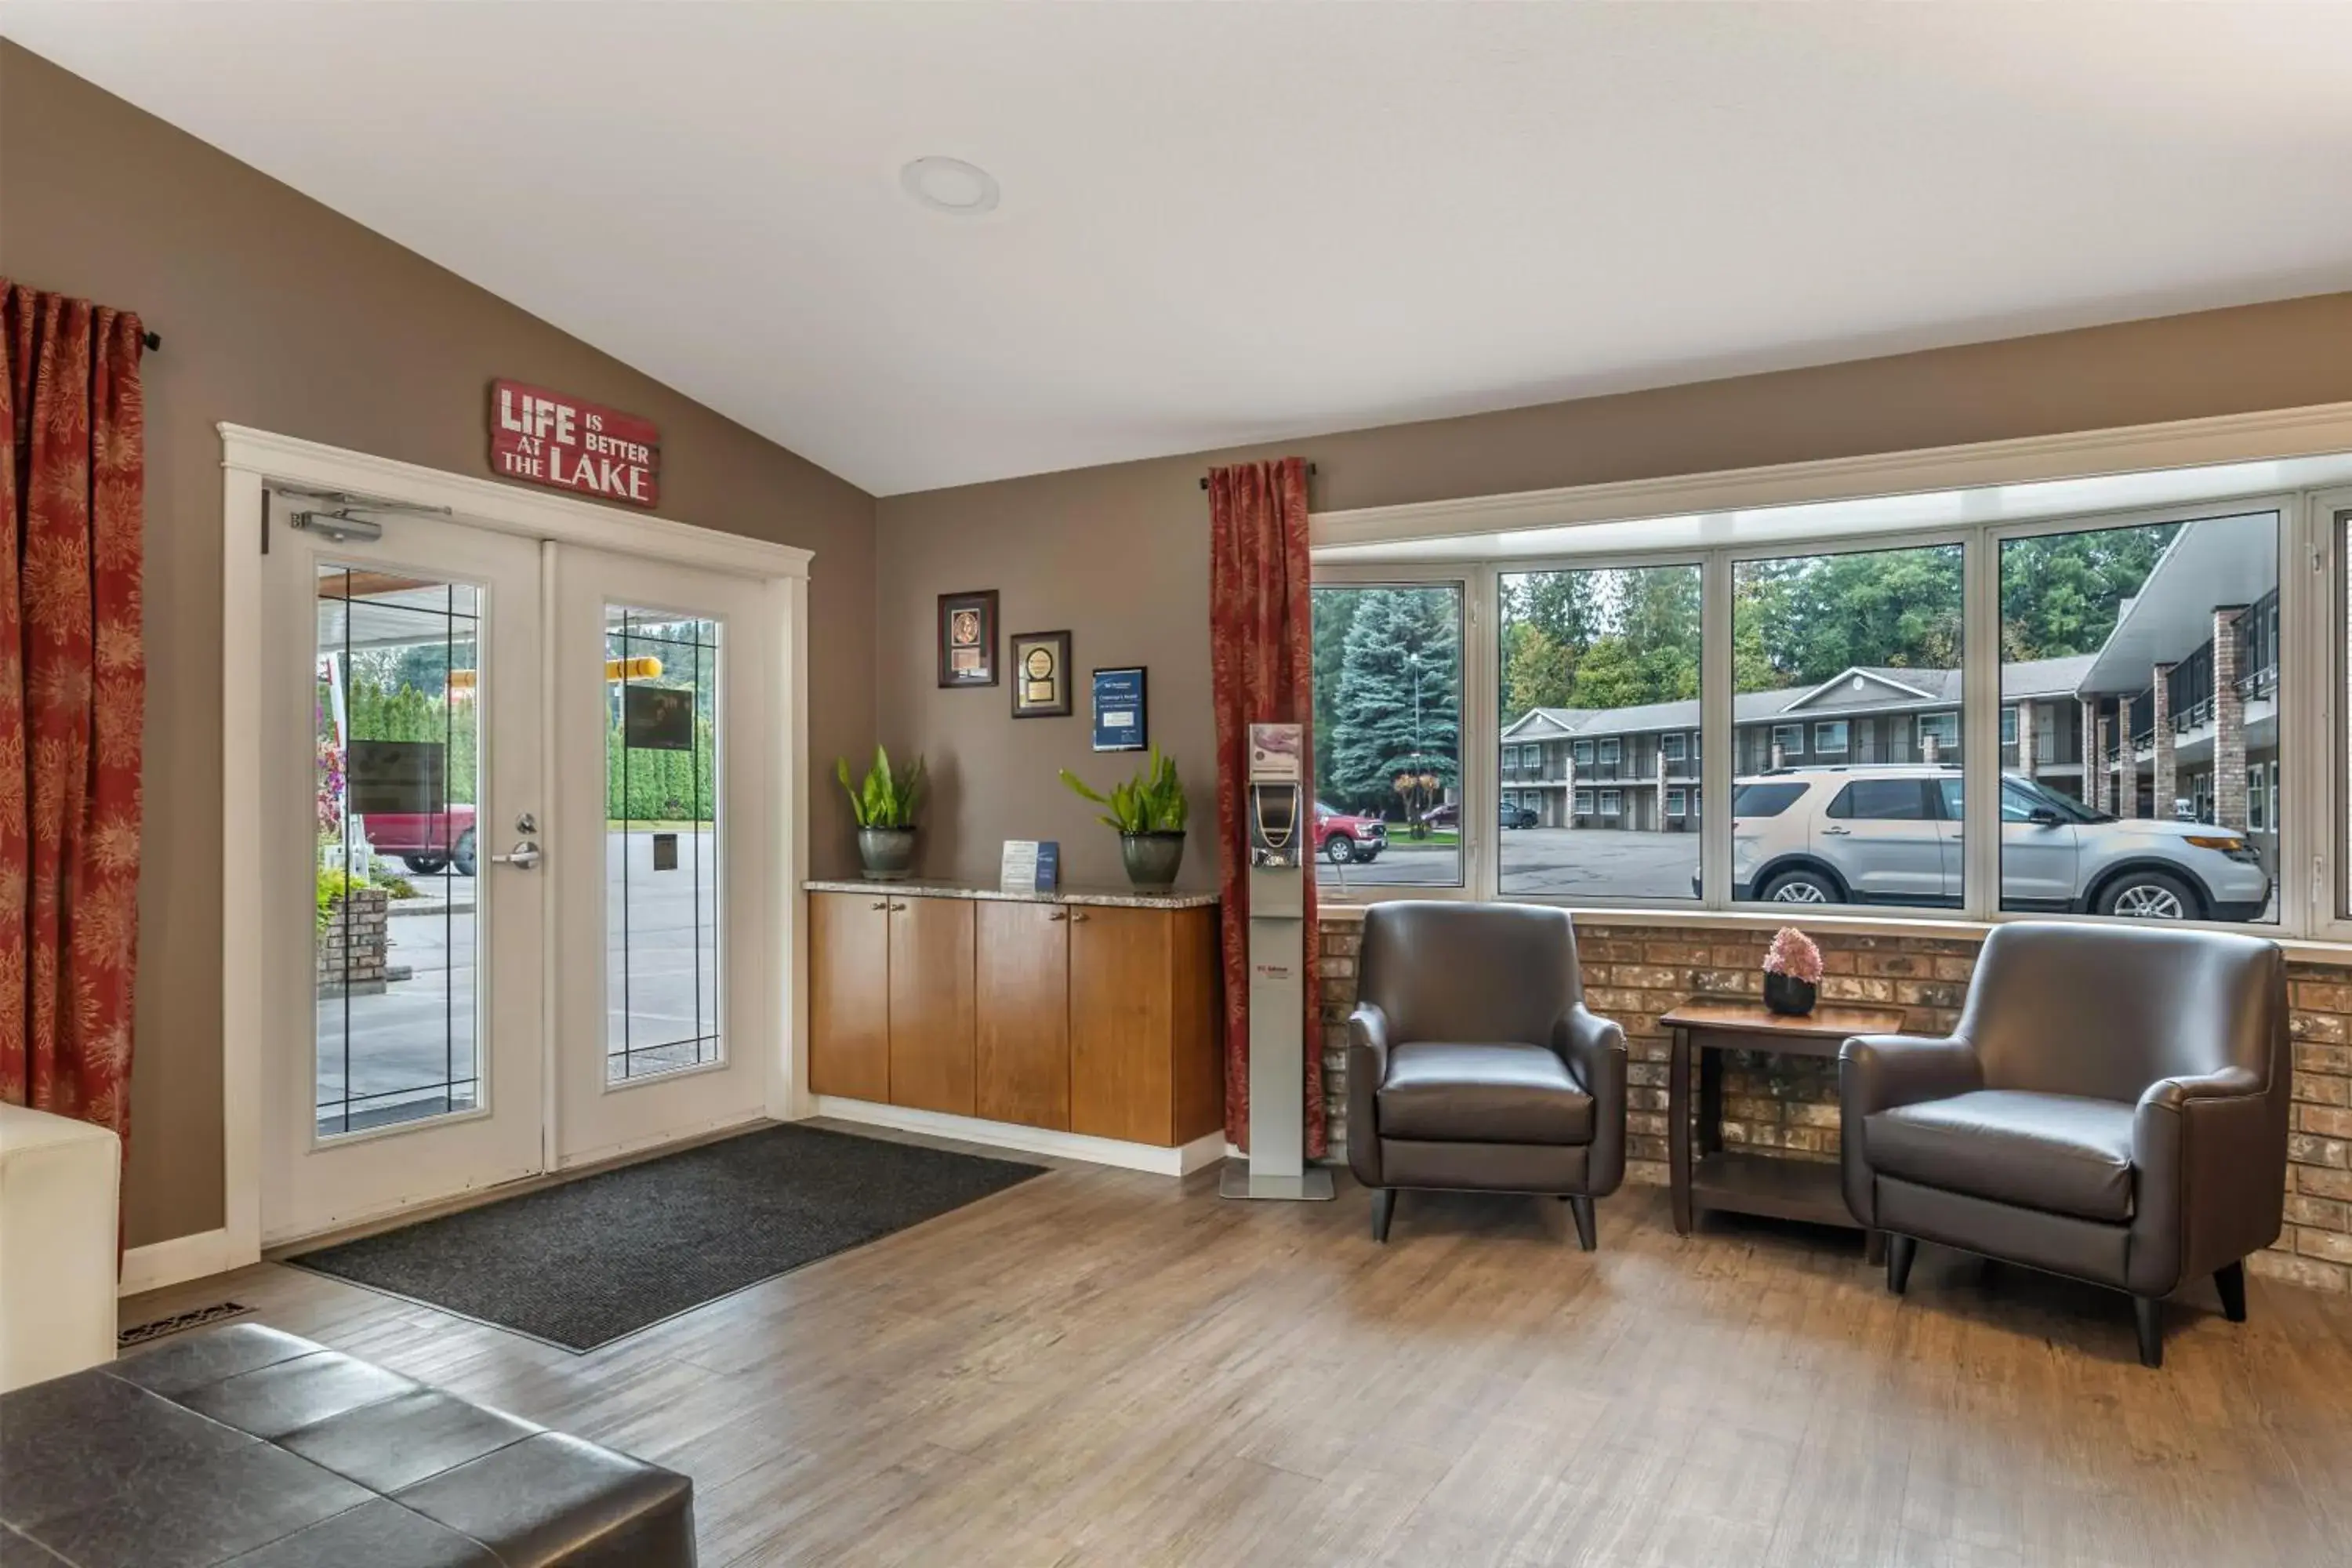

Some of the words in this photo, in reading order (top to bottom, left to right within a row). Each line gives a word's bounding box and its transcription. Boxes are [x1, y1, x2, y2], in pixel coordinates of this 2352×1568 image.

[501, 389, 576, 445] LIFE
[586, 413, 603, 431] IS
[517, 436, 545, 456] AT
[586, 432, 649, 464] BETTER
[501, 451, 545, 477] THE
[550, 446, 649, 501] LAKE
